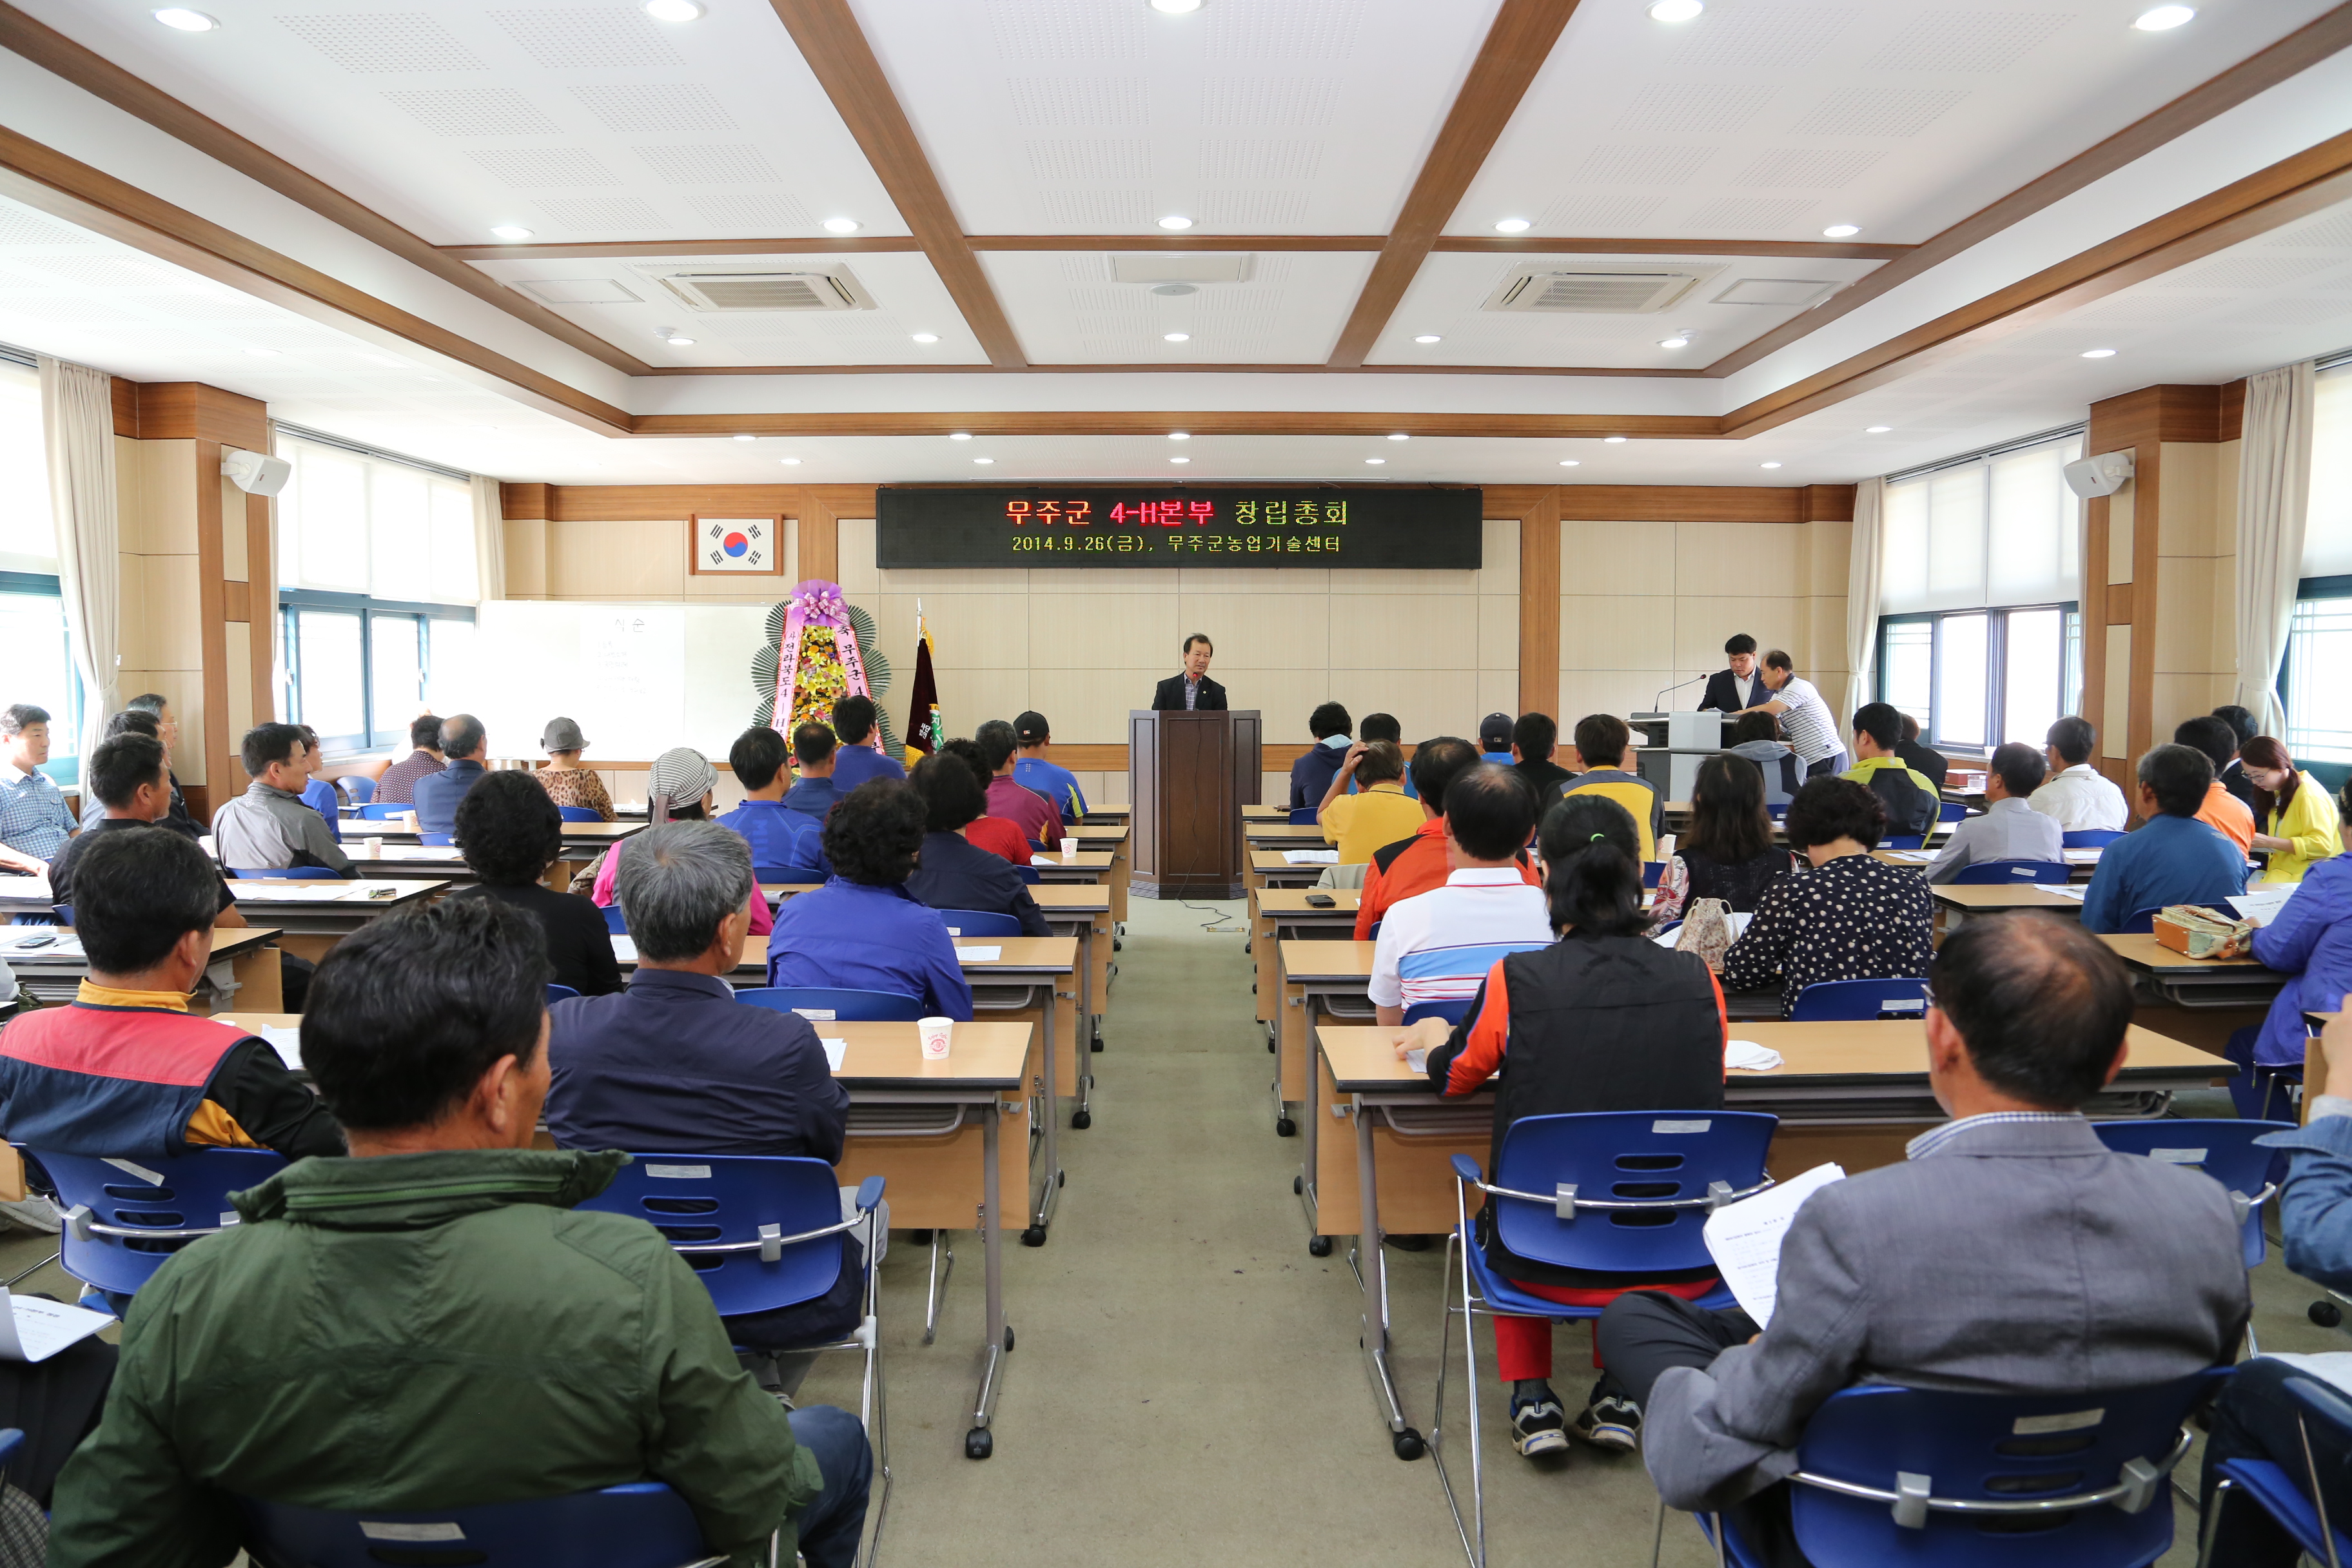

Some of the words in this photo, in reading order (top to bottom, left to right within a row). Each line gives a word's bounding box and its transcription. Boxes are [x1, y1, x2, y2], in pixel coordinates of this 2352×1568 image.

[1006, 500, 1092, 525] 무주군
[1109, 500, 1214, 525] 4-H본부
[1235, 500, 1348, 525] 창립총회
[1012, 534, 1153, 553] 2014.9.26(금),
[1168, 534, 1340, 553] 무주군농업기술센터
[841, 644, 863, 680] 무주군
